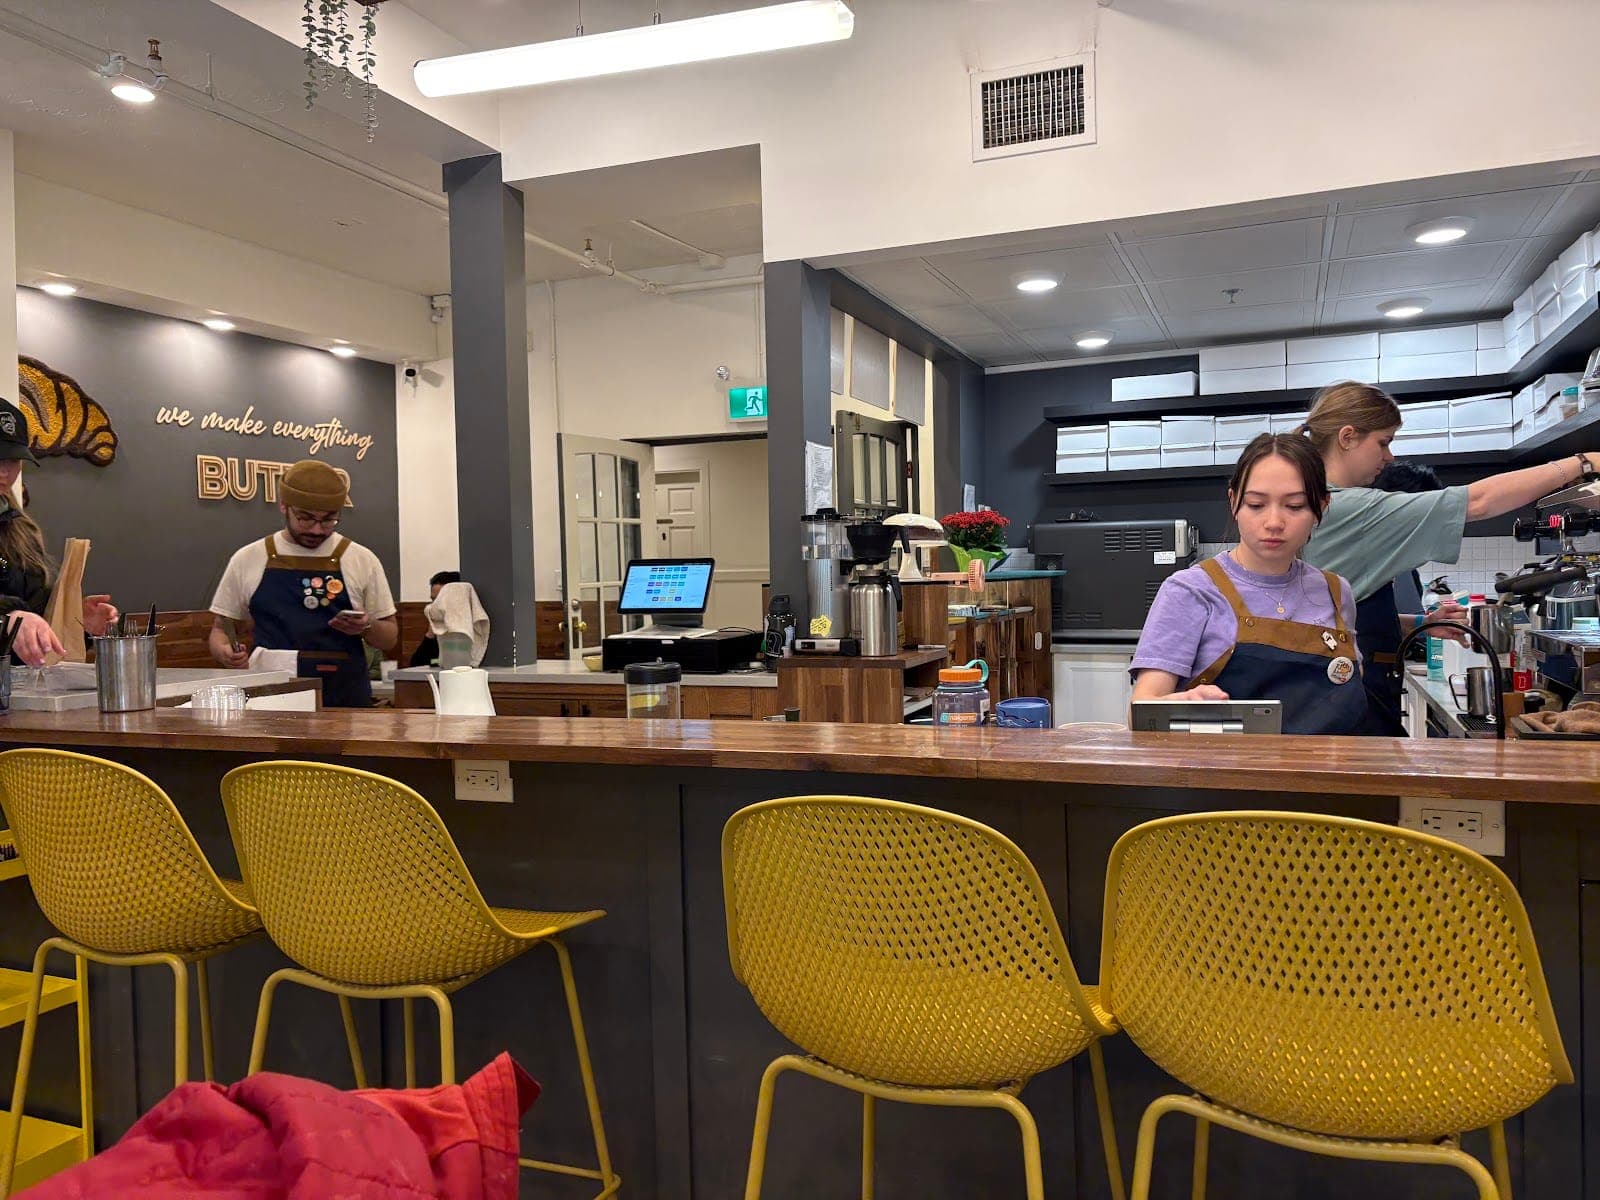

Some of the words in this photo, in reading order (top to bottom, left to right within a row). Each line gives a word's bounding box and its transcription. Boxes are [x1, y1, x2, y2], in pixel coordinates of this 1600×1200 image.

[156, 406, 194, 427] we
[201, 405, 267, 436] make
[272, 417, 375, 461] everything
[196, 454, 354, 508] BUT
